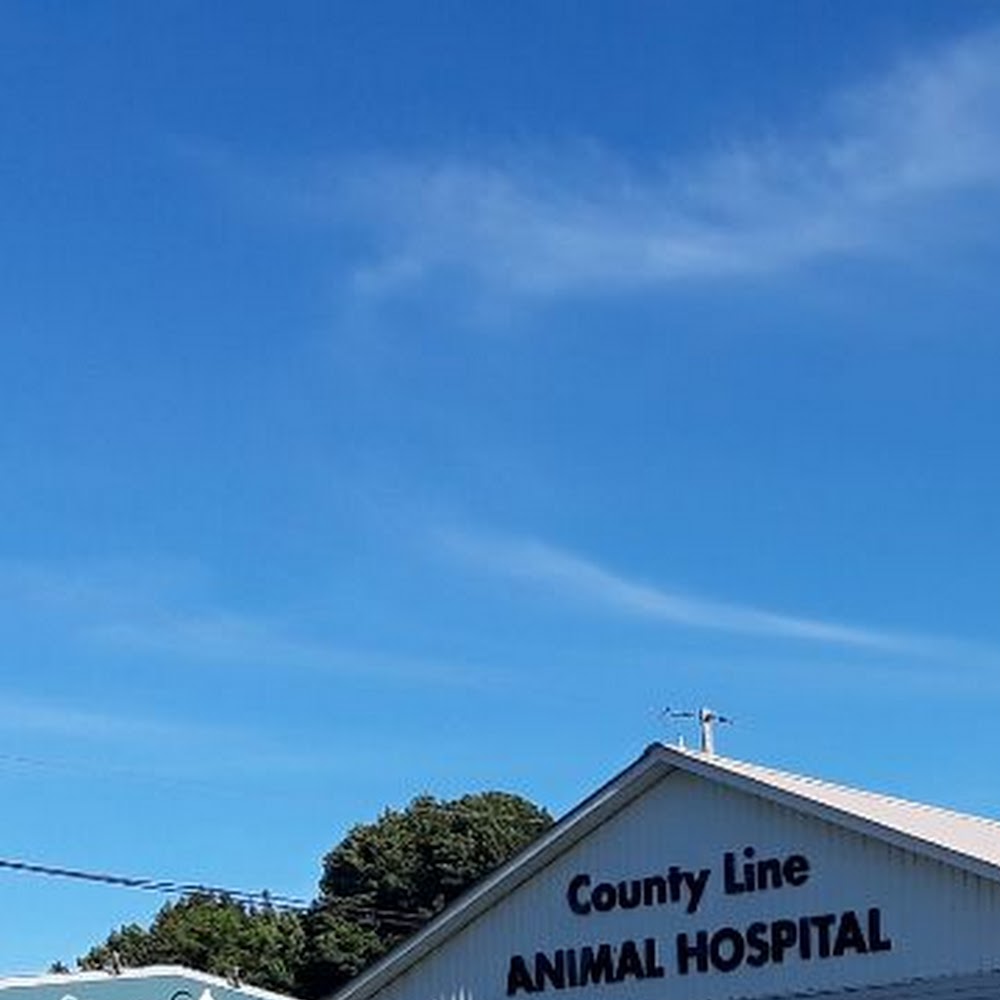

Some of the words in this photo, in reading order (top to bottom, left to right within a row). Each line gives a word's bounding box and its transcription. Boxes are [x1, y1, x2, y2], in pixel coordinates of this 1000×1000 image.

[566, 865, 710, 915] County
[723, 847, 810, 895] Line
[507, 938, 665, 996] ANIMAL
[676, 908, 892, 975] HOSPITAL
